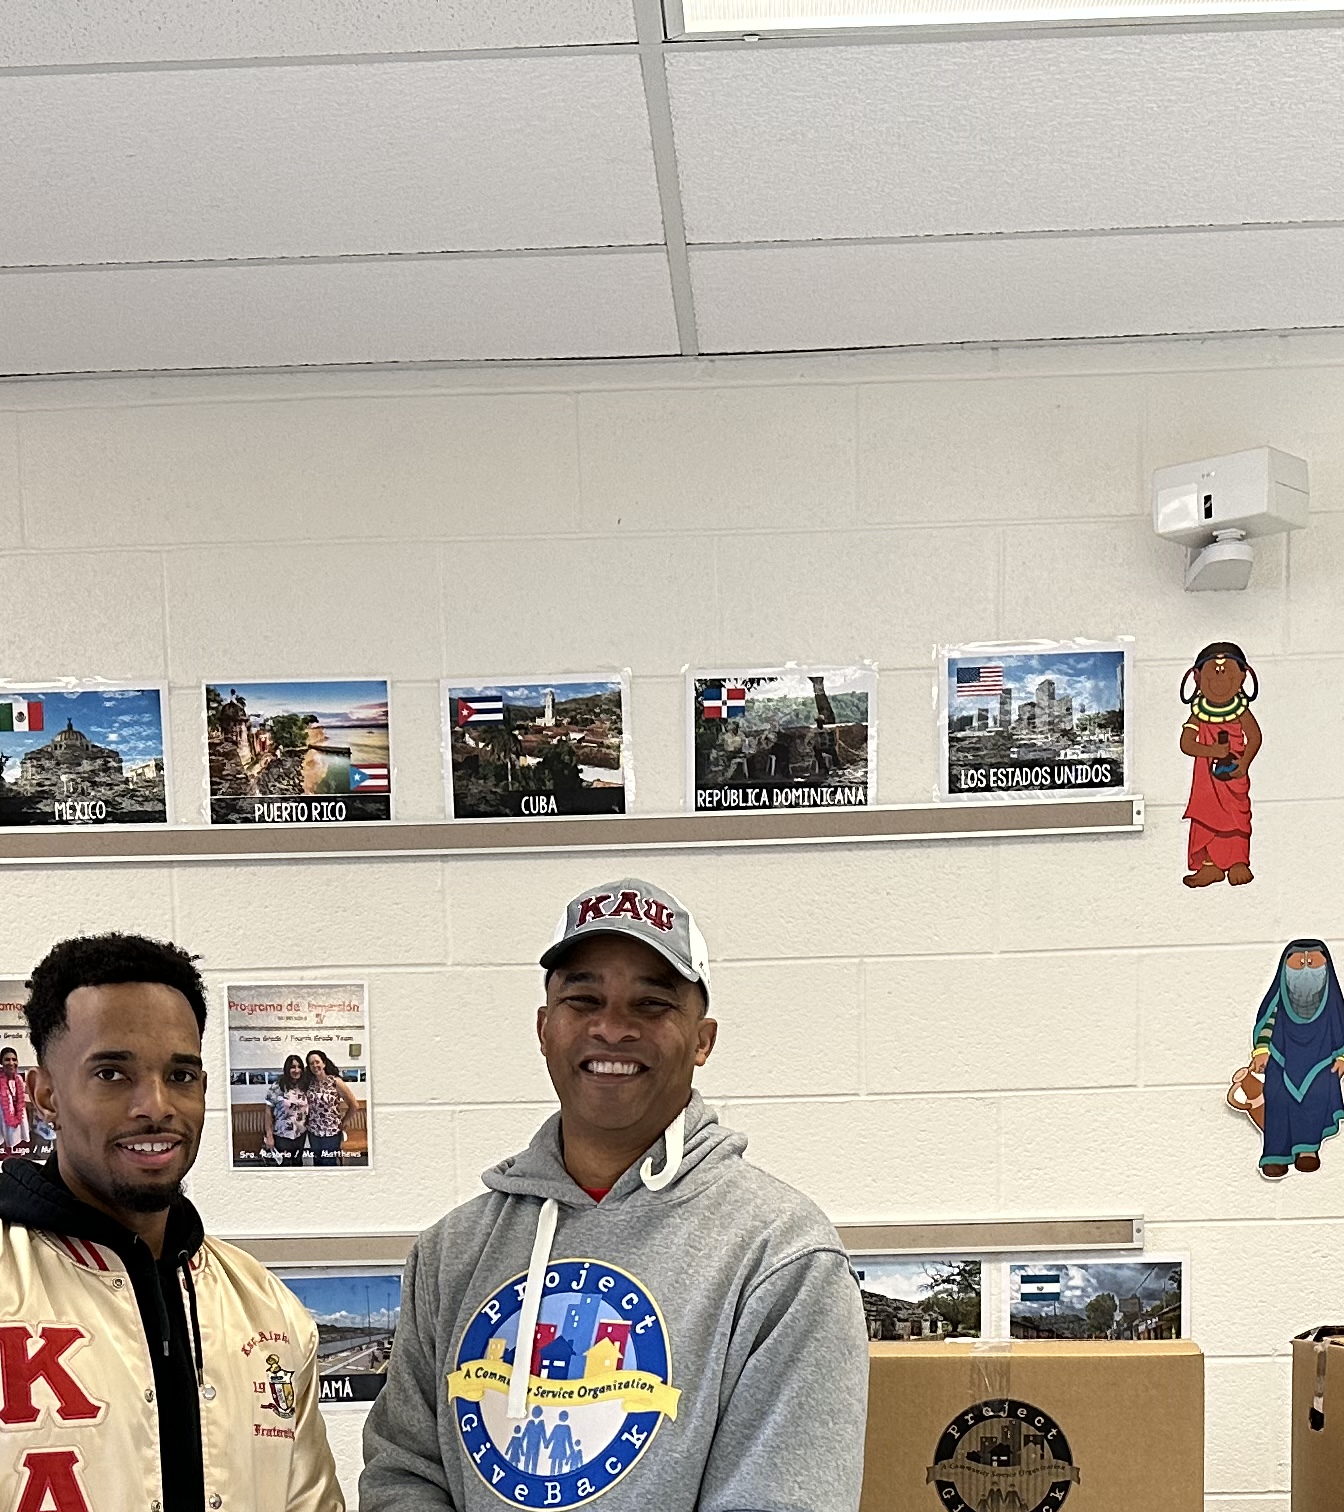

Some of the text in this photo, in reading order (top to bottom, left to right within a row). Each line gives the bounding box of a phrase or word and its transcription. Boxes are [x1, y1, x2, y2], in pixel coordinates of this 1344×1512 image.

[959, 763, 1112, 789] LOS ESTADOS UNIDOS
[521, 795, 558, 814] CUBA
[696, 786, 866, 808] REPÚBLICA DOMINICANA
[55, 798, 106, 821] MÉXICO
[255, 802, 346, 822] PUERTO RICO
[228, 1001, 283, 1015] Programa
[286, 1001, 301, 1012] de
[239, 1150, 258, 1159] Sra.
[482, 1262, 656, 1335] Project
[253, 1381, 266, 1394] 19
[464, 1368, 471, 1379] A
[533, 1386, 574, 1399] Service
[577, 1378, 655, 1399] Organization
[947, 1401, 1059, 1440] Project
[461, 1412, 648, 1505] GiveBack
